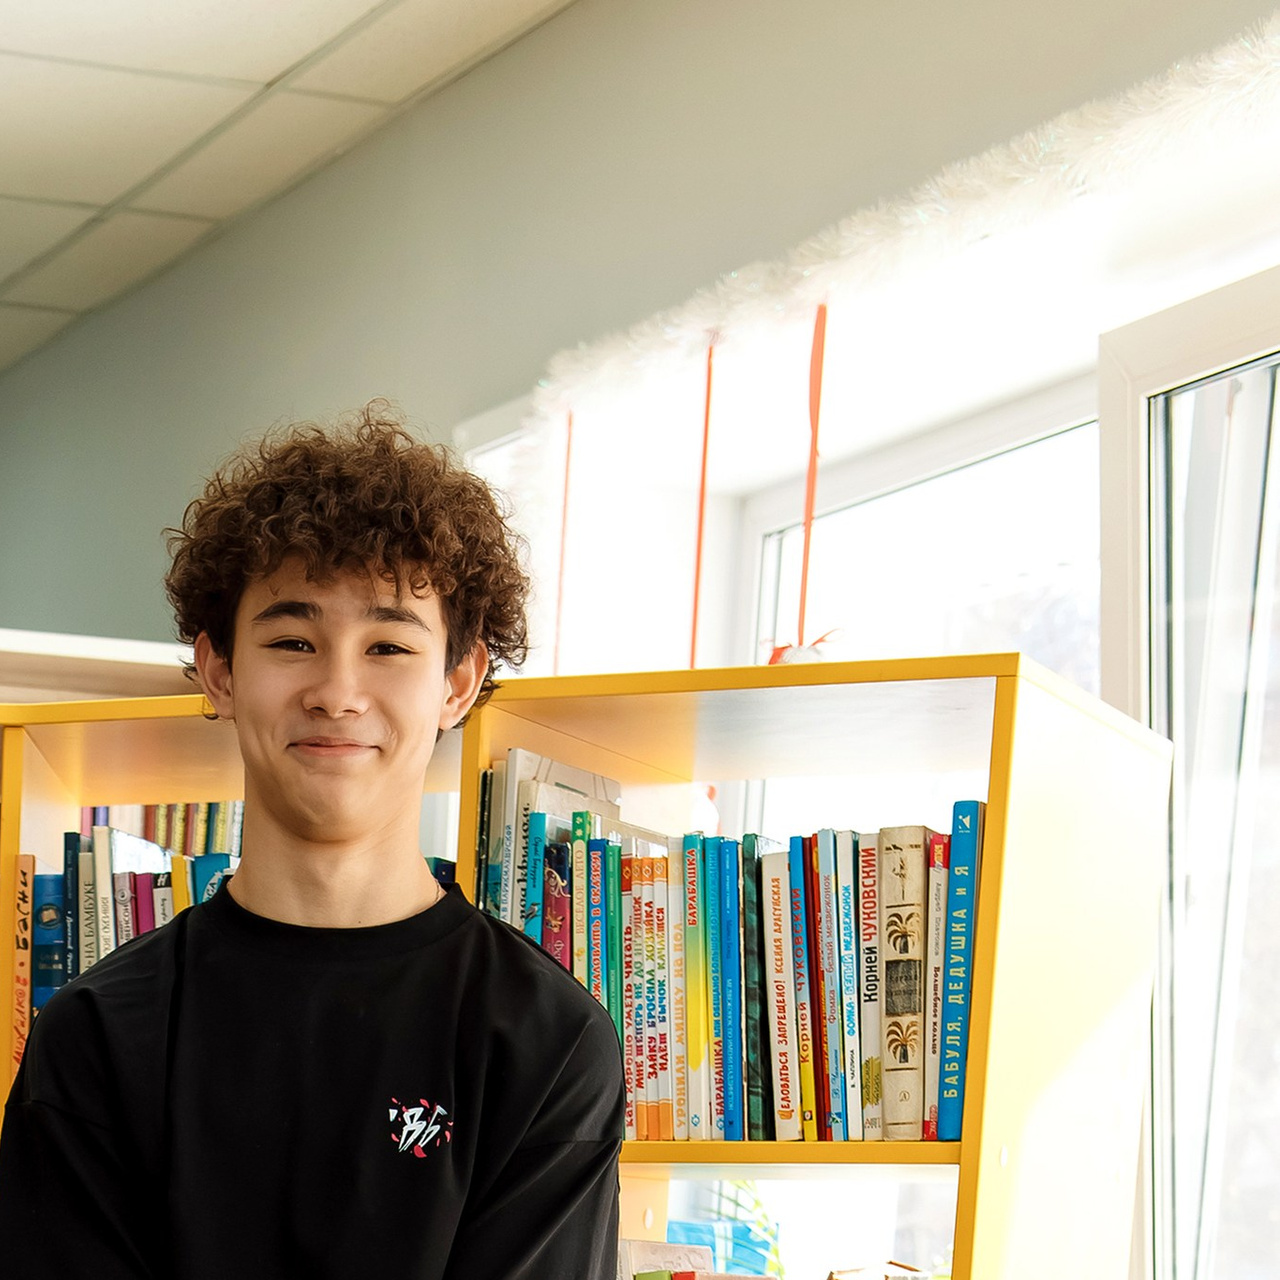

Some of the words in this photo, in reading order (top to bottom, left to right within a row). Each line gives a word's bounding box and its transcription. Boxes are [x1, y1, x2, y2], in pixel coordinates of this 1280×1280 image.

[686, 848, 698, 926] БАРАБАШКА
[860, 846, 877, 942] ЧУКОВСКИЙ
[954, 865, 969, 876] Я
[83, 880, 95, 938] БАМБУКЕ
[770, 876, 783, 934] ДРАГУНСКАЯ
[822, 873, 834, 938] медвежонок
[841, 883, 853, 951] МЕДВЕЖОНОК
[673, 956, 685, 979] НА
[773, 936, 784, 973] КСЕНИЯ
[791, 887, 806, 991] ЧУКОВСКИЙ
[824, 939, 835, 973] белый
[947, 907, 968, 1004] ДЕДУШКА
[644, 968, 657, 1028] БРОСИЛА
[862, 944, 880, 1003] Корней
[931, 965, 941, 1019] Волшебное
[674, 985, 686, 1046] МИШКУ
[774, 978, 789, 1046] ЗАПРЕЩЕНО!
[796, 1000, 811, 1064] Корней
[826, 988, 838, 1024] Фомка
[845, 1001, 856, 1037] ФОМКА
[644, 1035, 658, 1080] ЗАЙКУ
[711, 1039, 725, 1116] БАРАБАШКА
[777, 1050, 794, 1120] ЦЕЛОВАТЬСЯ
[942, 1015, 963, 1098] БАБУЛЯ,
[674, 1054, 687, 1128] УРОНИЛИ
